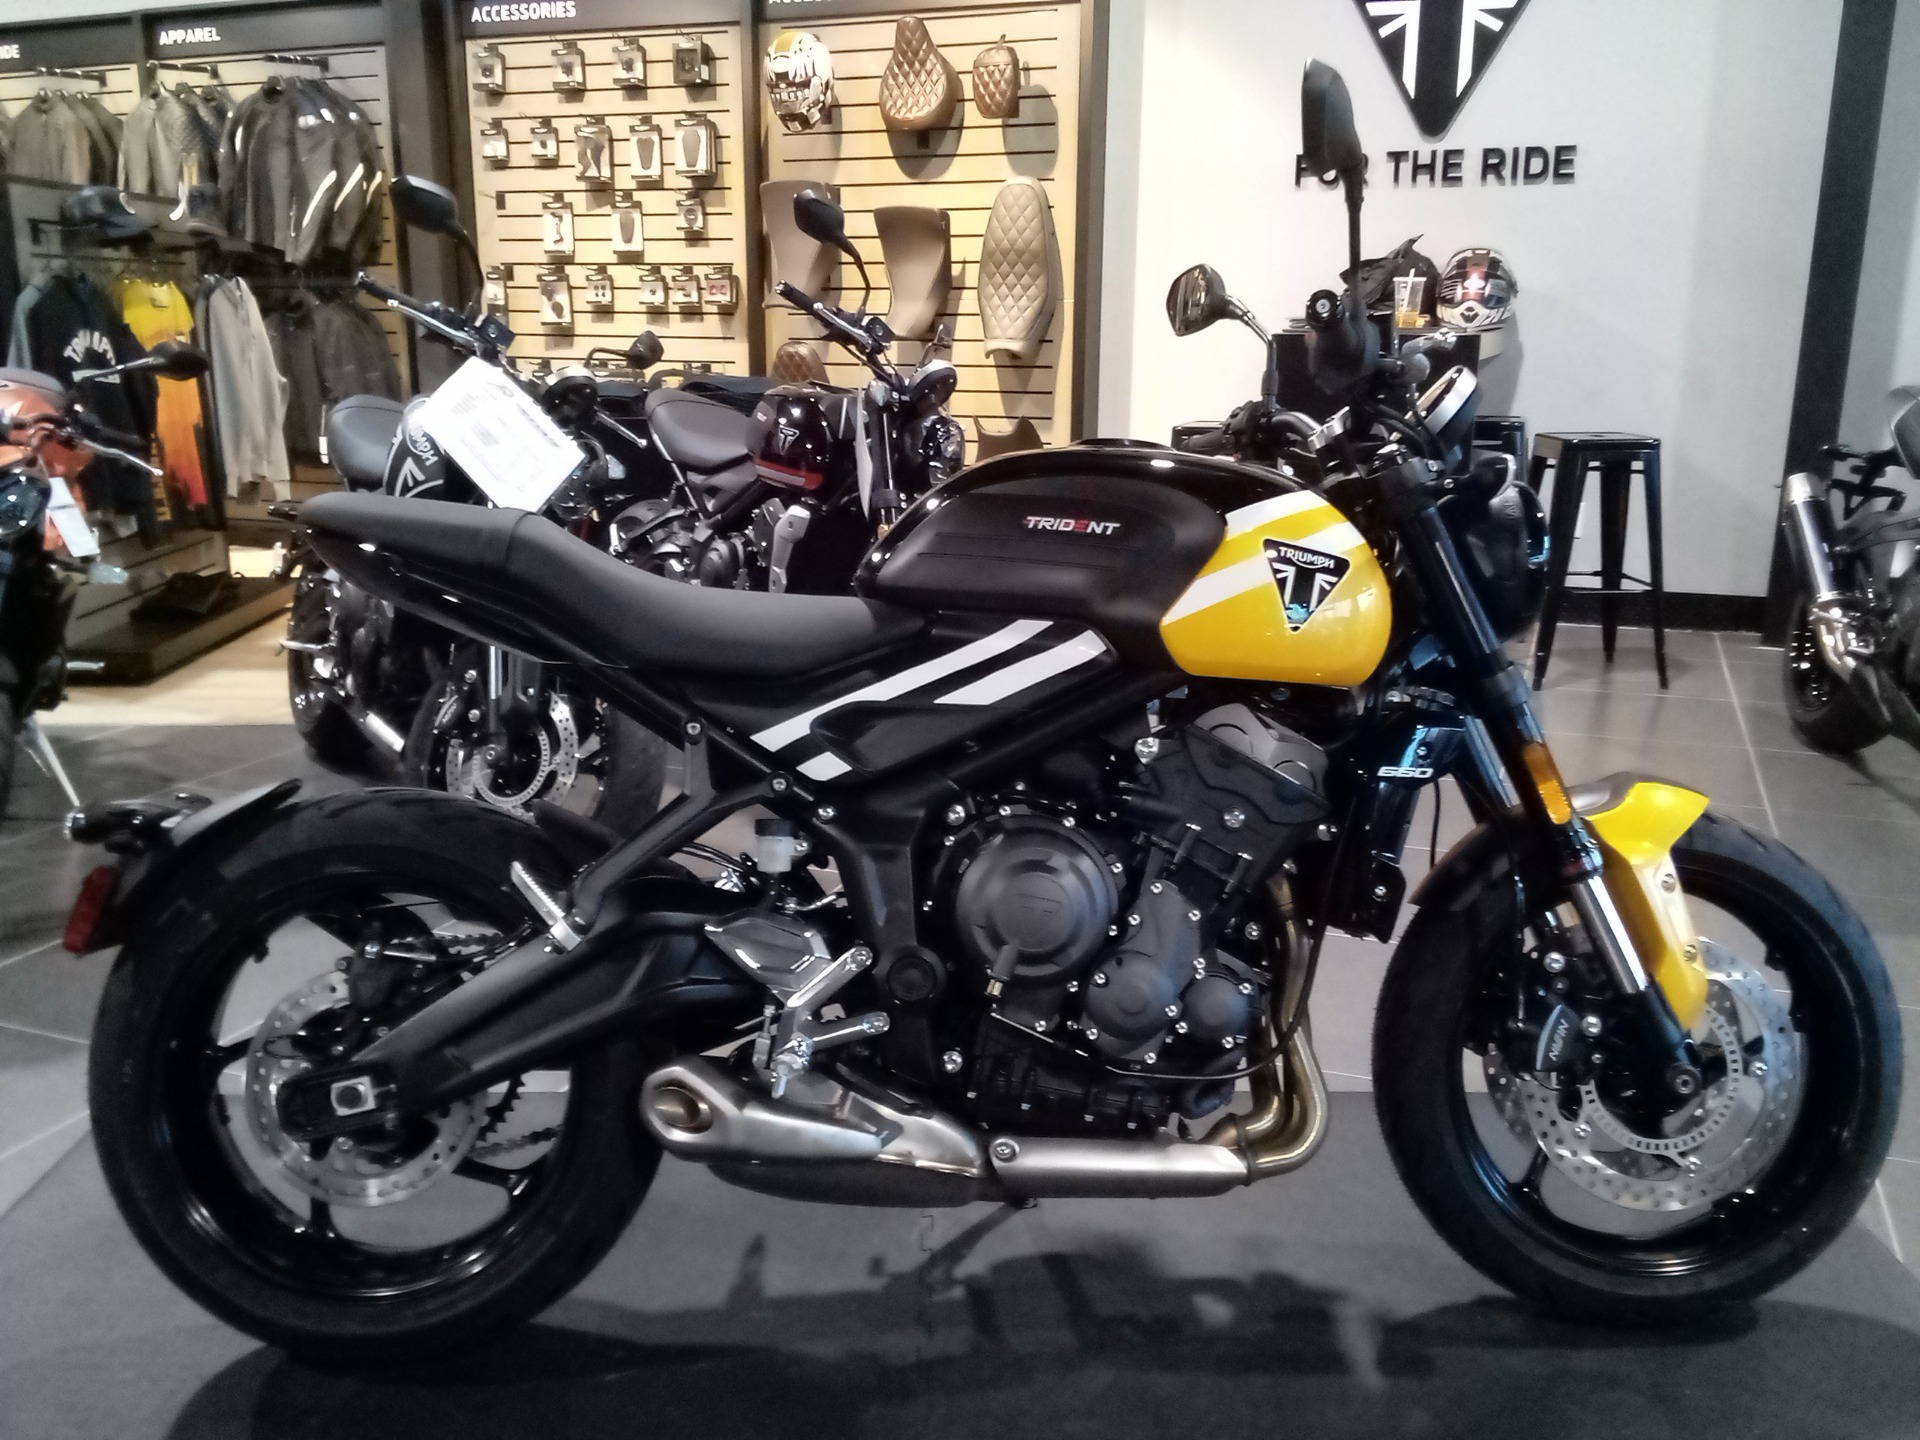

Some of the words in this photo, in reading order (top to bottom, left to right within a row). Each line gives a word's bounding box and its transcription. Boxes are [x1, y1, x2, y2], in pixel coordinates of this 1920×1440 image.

[471, 1, 577, 23] ACCESSORIES
[159, 27, 221, 45] APPAREL
[1386, 149, 1465, 187] THE
[1481, 145, 1577, 186] RIDE
[1026, 516, 1121, 535] TRIDENT
[1279, 546, 1335, 569] TRIUMPH
[1377, 766, 1434, 778] 660
